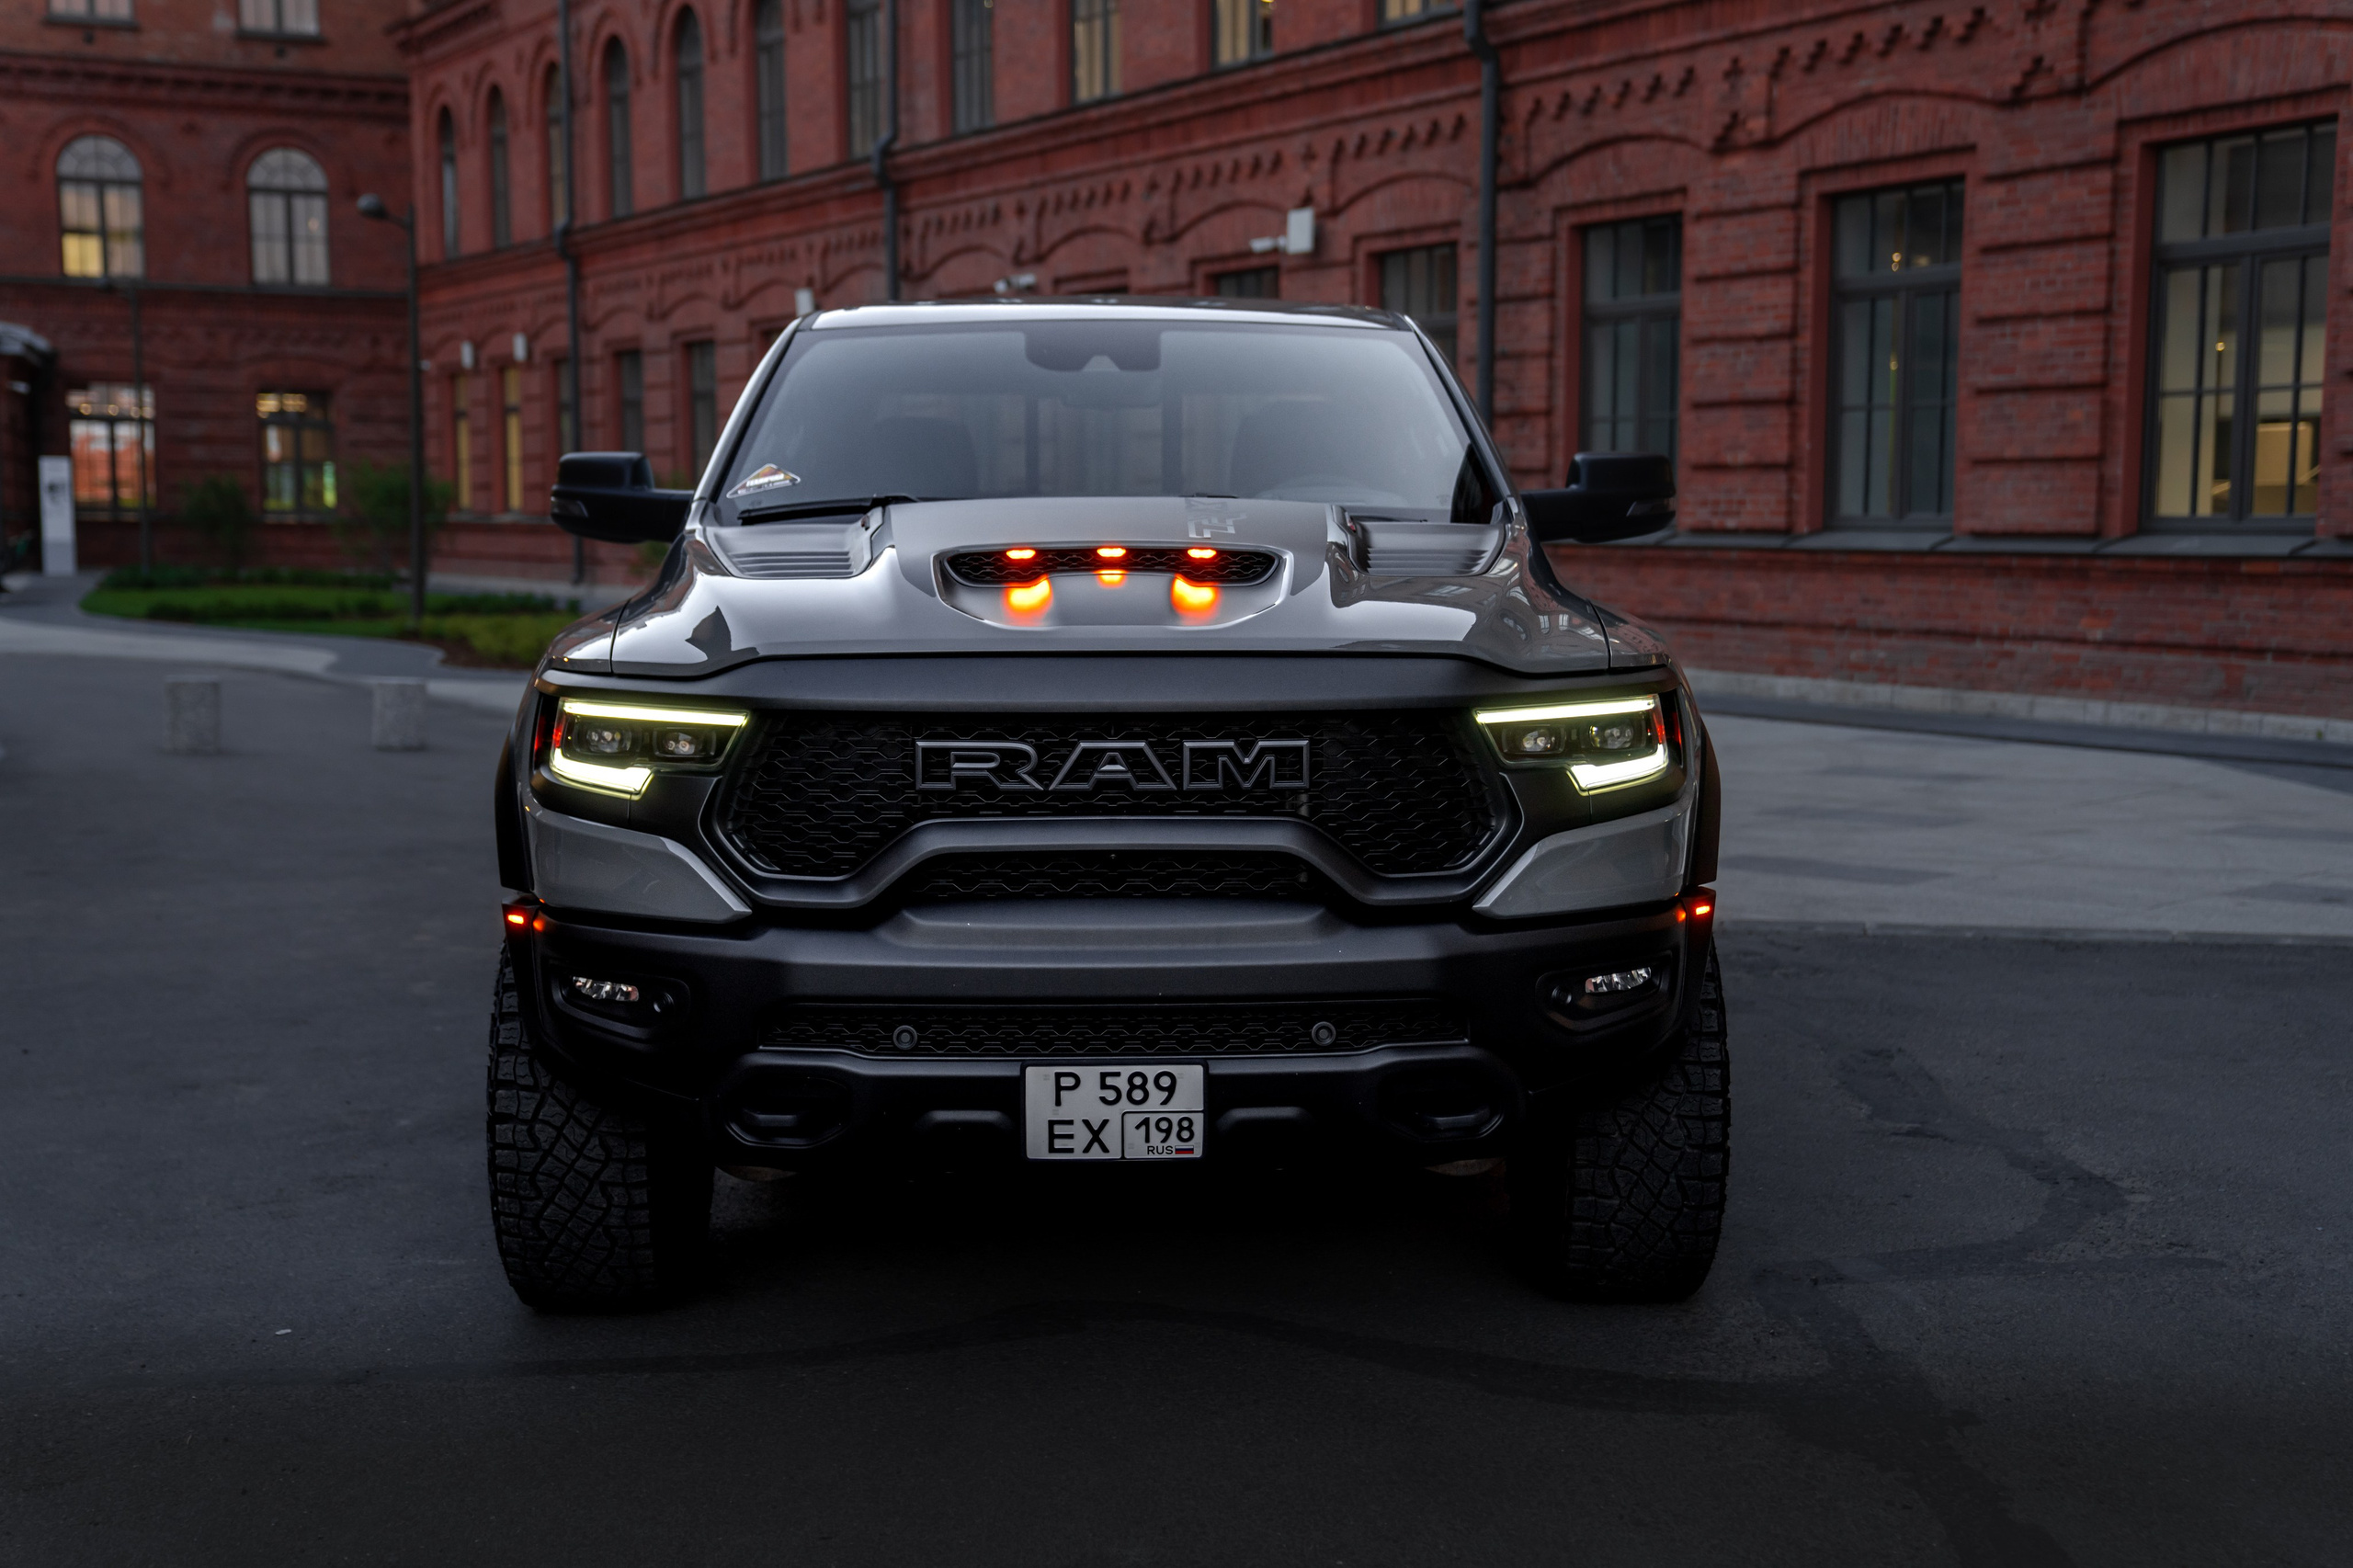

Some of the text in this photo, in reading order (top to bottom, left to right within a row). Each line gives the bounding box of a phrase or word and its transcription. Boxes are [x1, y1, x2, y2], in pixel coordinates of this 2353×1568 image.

[915, 739, 1310, 790] RAM
[1054, 1070, 1177, 1107] P 589
[1047, 1119, 1110, 1153] EX
[1134, 1116, 1195, 1143] 198
[1146, 1145, 1174, 1155] RUS
